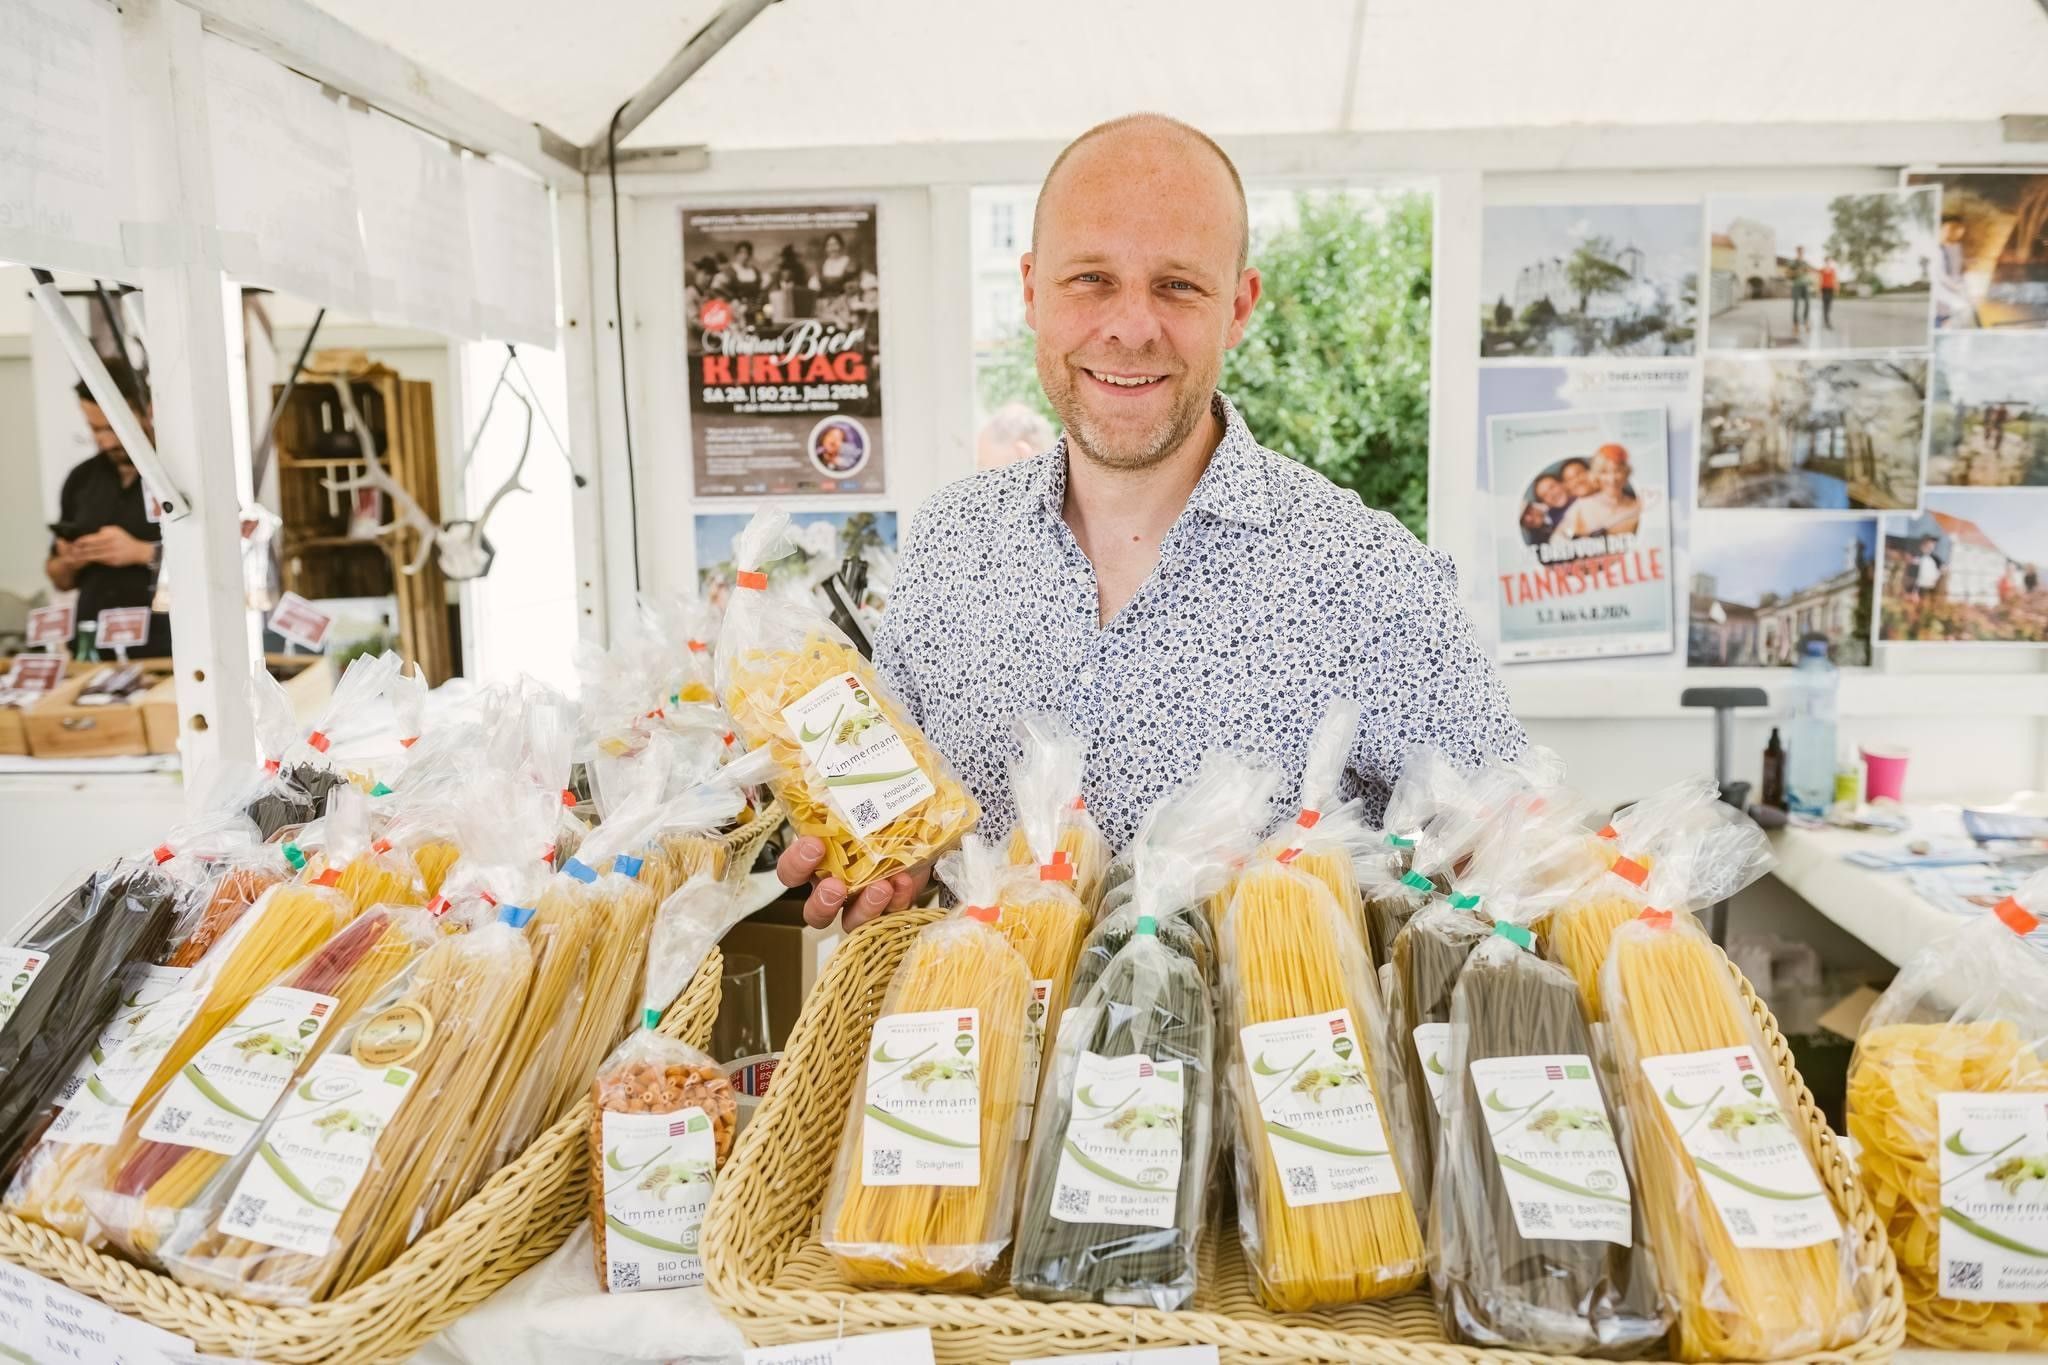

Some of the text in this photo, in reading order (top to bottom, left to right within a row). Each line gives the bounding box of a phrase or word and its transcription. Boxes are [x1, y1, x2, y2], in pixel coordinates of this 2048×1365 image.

[771, 320, 865, 366] Bier
[703, 351, 868, 385] KIRTAG
[1500, 548, 1665, 608] TANKSTELLE
[882, 776, 918, 799] Knoblauch
[886, 783, 927, 809] Bandnudeln
[916, 1160, 964, 1171] Spaghetti
[1330, 1177, 1378, 1191] Spaghetti
[1104, 1206, 1160, 1217] Spaghetti
[682, 1229, 698, 1247] BI
[657, 1259, 702, 1272] BIO Chil
[658, 1271, 704, 1284] Hörnche
